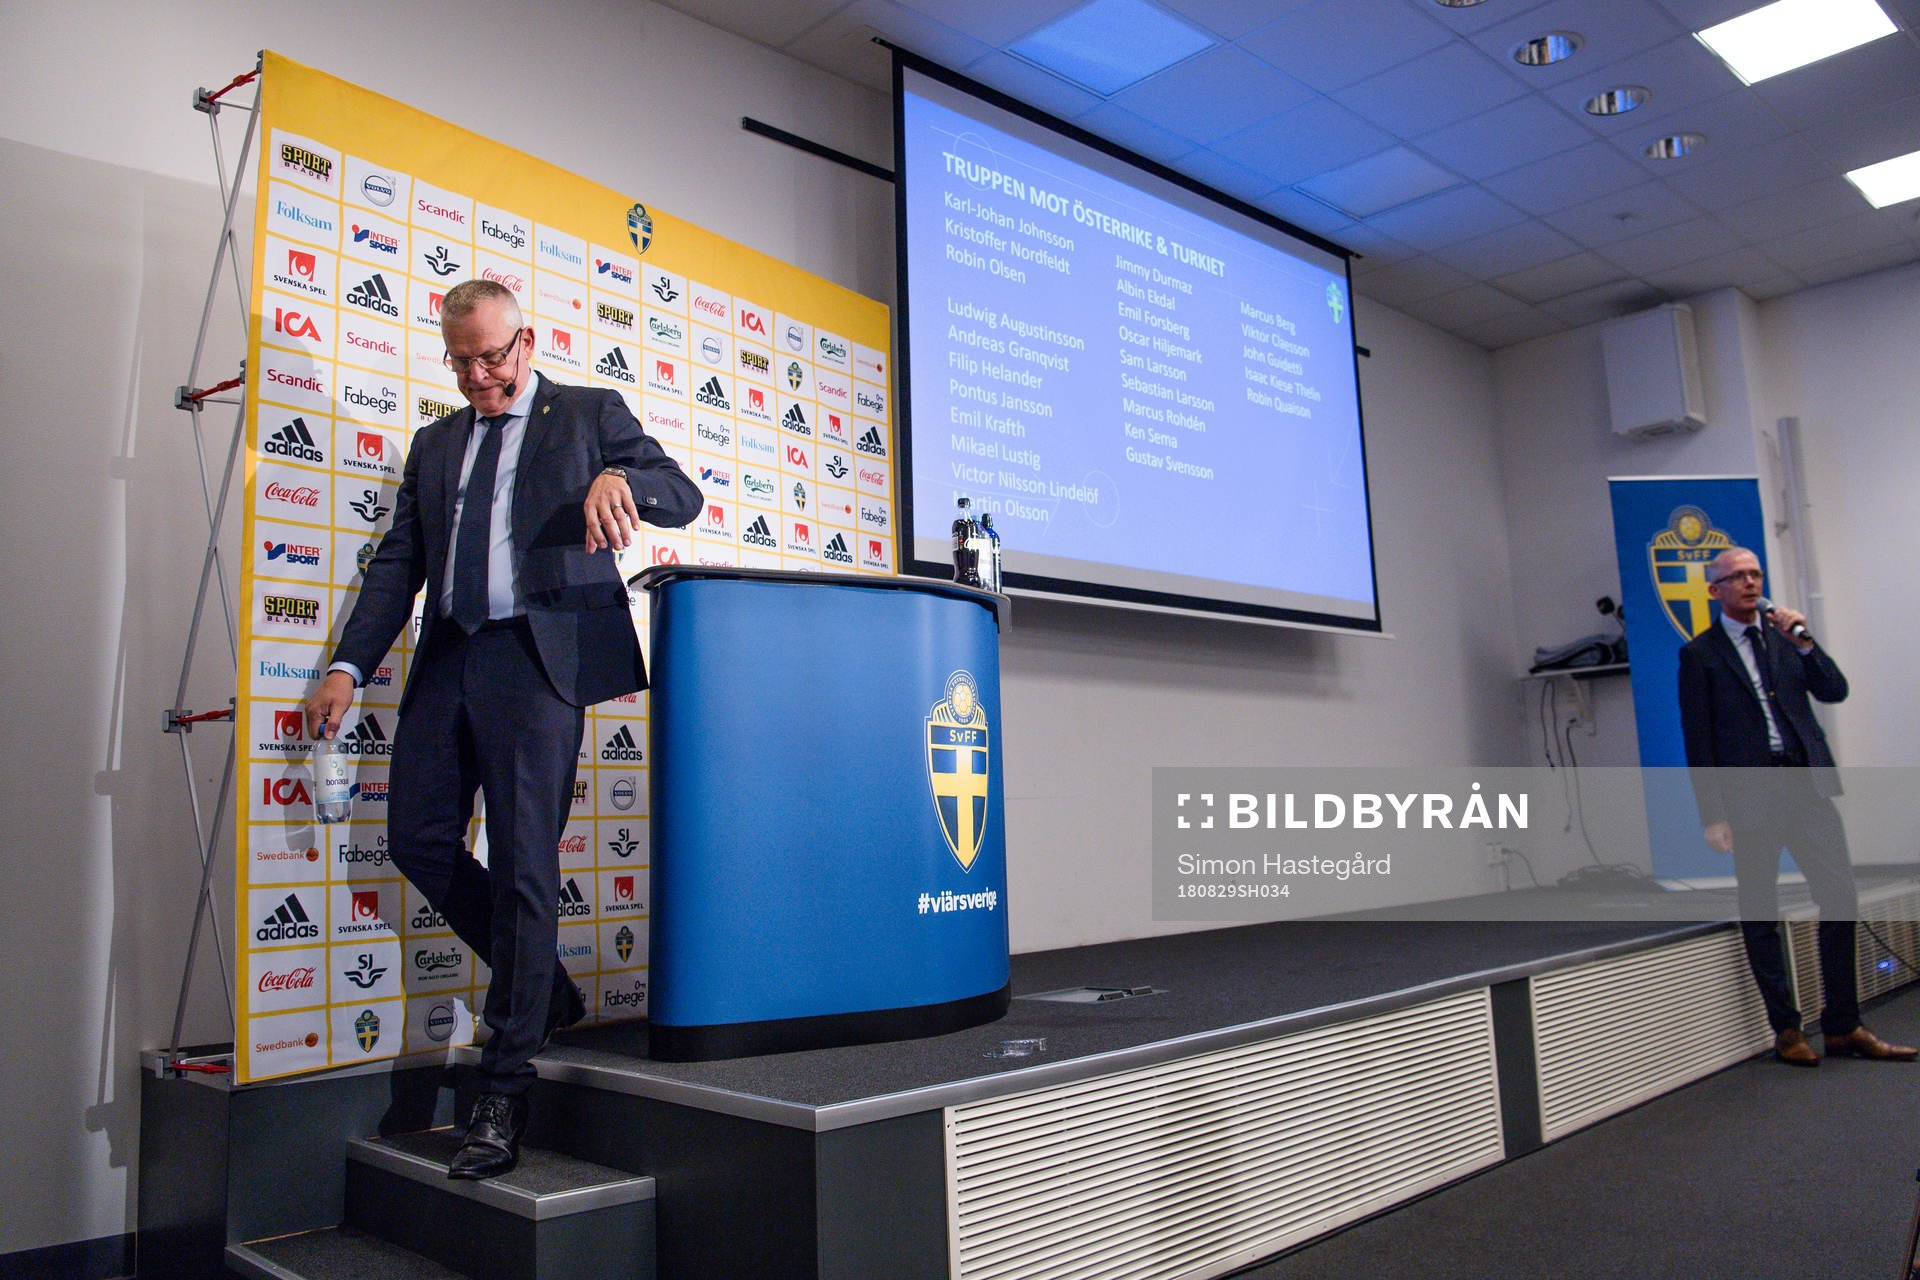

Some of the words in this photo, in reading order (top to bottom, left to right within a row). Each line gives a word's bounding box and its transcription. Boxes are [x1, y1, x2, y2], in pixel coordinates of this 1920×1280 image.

[282, 144, 332, 176] SPORT
[284, 161, 330, 182] BLADET
[365, 183, 391, 195] VOLVO
[277, 201, 332, 231] Folksam
[418, 200, 465, 224] Scandic
[942, 152, 1024, 200] TRUPPEN
[1030, 187, 1069, 216] MOT
[1074, 200, 1152, 250] ÖSTERRIKE
[1156, 236, 1168, 255] &
[1170, 241, 1225, 278] TURKIET
[944, 192, 1014, 230] Karl-Johan
[1018, 218, 1074, 251] Johnsson
[370, 231, 398, 246] INTER
[482, 221, 525, 248] Fabege
[369, 241, 397, 254] SPORT
[436, 246, 448, 261] SJ
[540, 240, 582, 264] Folksam
[946, 218, 1006, 251] Kristoffer
[1010, 241, 1070, 274] Nordfeldt
[611, 264, 632, 276] INTER
[946, 244, 986, 270] Robin
[990, 259, 1026, 284] Olsen
[274, 274, 307, 291] SVENSKA
[309, 282, 327, 296] SPEL
[611, 272, 632, 284] SPORT
[661, 276, 670, 290] SJ
[1116, 255, 1150, 281] Jimmy
[1152, 268, 1192, 296] Durmaz
[347, 292, 398, 317] adidas
[1116, 278, 1145, 300] Albin
[1148, 290, 1176, 311] Ekdal
[276, 307, 322, 342] ICA
[598, 303, 633, 326] SPORT
[741, 309, 766, 336] ICA
[948, 297, 997, 328] Ludwig
[1000, 314, 1084, 350] Augustinsson
[1118, 302, 1142, 322] Emil
[1145, 312, 1190, 341] Forsberg
[1240, 300, 1275, 325] Marcus
[1276, 314, 1296, 336] Berg
[650, 317, 681, 339] Carlsberg
[347, 332, 397, 356] Scandic
[820, 338, 846, 357] Carlsberg
[948, 324, 1005, 354] Andreas
[1009, 341, 1070, 372] Granqvist
[1119, 326, 1150, 348] Oscar
[1153, 336, 1202, 364] Hiljemark
[1244, 344, 1266, 363] John
[542, 350, 567, 362] SVENSKA
[568, 359, 580, 367] SPEL
[740, 350, 768, 370] SPORT
[1120, 349, 1144, 370] Sam
[1147, 358, 1187, 382] Larsson
[596, 363, 635, 383] adidas
[949, 352, 978, 376] Filip
[982, 364, 1042, 389] Helander
[267, 369, 323, 393] Scandic
[649, 381, 671, 392] SVENSKA
[819, 382, 847, 398] Scandic
[344, 386, 396, 414] Fabege
[696, 392, 730, 410] adidas
[950, 379, 998, 406] Pontus
[1000, 392, 1052, 418] Jansson
[1121, 373, 1174, 400] Sebastian
[1177, 389, 1214, 413] Larsson
[1247, 387, 1273, 408] Robin
[419, 398, 461, 418] SPORT
[741, 408, 762, 418] SVENSKA
[858, 394, 884, 413] Fabege
[1123, 398, 1164, 422] Marcus
[648, 412, 684, 431] Scandic
[782, 419, 811, 436] adidas
[951, 406, 981, 428] Emil
[986, 414, 1026, 438] Krafth
[698, 424, 730, 446] Fabege
[741, 435, 774, 454] Folksam
[1124, 422, 1144, 441] Ken
[1148, 428, 1178, 448] Sema
[264, 440, 323, 462] adidas
[787, 445, 808, 468] ICA
[856, 440, 886, 457] adidas
[951, 434, 998, 458] Mikael
[1002, 444, 1040, 471] Lustig
[344, 459, 378, 471] SVENSKA
[380, 464, 396, 474] SPEL
[834, 456, 842, 466] SJ
[1126, 446, 1164, 469] Gustav
[1166, 456, 1214, 480] Svensson
[713, 470, 730, 480] INTER
[713, 477, 730, 486] SPORT
[744, 474, 774, 493] Carlsberg
[952, 462, 995, 485] Victor
[999, 470, 1046, 495] Nilsson
[1050, 482, 1099, 504] Lindelöf
[364, 490, 378, 505] SJ
[861, 508, 886, 526] Fabege
[1005, 500, 1048, 522] Olsson
[700, 528, 720, 536] SVENSKA
[743, 533, 776, 548] adidas
[286, 554, 320, 566] SPORT
[287, 544, 320, 556] INTER
[652, 545, 680, 565] ICA
[824, 548, 852, 564] adidas
[1677, 550, 1710, 560] SvFF
[264, 596, 320, 619] SPORT
[268, 616, 318, 626] BLADET
[260, 661, 320, 680] Folksam
[950, 729, 978, 742] SvFF
[259, 744, 296, 752] SVENSKA
[602, 748, 642, 760] adidas
[264, 778, 312, 806] ICA
[619, 828, 630, 842] SJ
[256, 850, 304, 861] Swedbank
[339, 844, 392, 866] Fabege
[606, 904, 630, 912] SVENSKA
[918, 887, 997, 915] #viärsverige
[256, 922, 318, 942] adidas
[338, 924, 372, 934] SVENSKA
[374, 922, 392, 931] SPEL
[358, 954, 372, 969] SJ
[415, 948, 462, 971] Carlsberg
[605, 990, 644, 1007] Fabege
[256, 1038, 304, 1052] Swedbank
